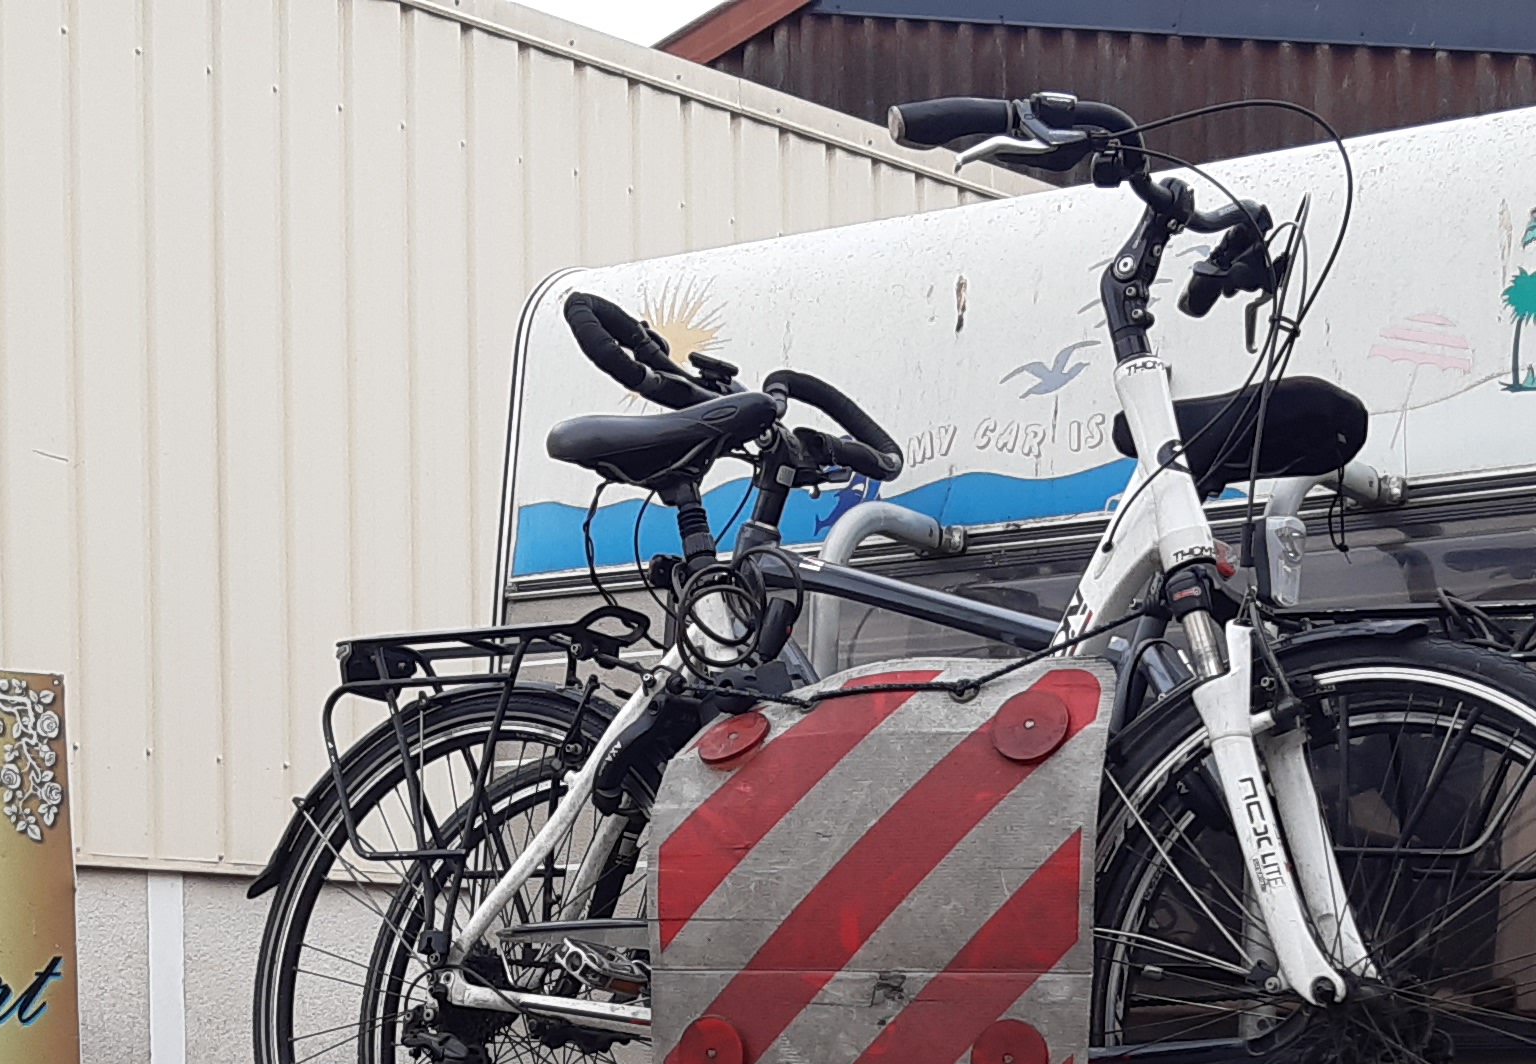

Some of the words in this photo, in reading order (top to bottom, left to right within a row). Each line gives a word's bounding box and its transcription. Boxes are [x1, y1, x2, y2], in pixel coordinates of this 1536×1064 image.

[907, 424, 958, 468] MY
[974, 416, 1047, 459] CAR
[1068, 412, 1106, 452] IS
